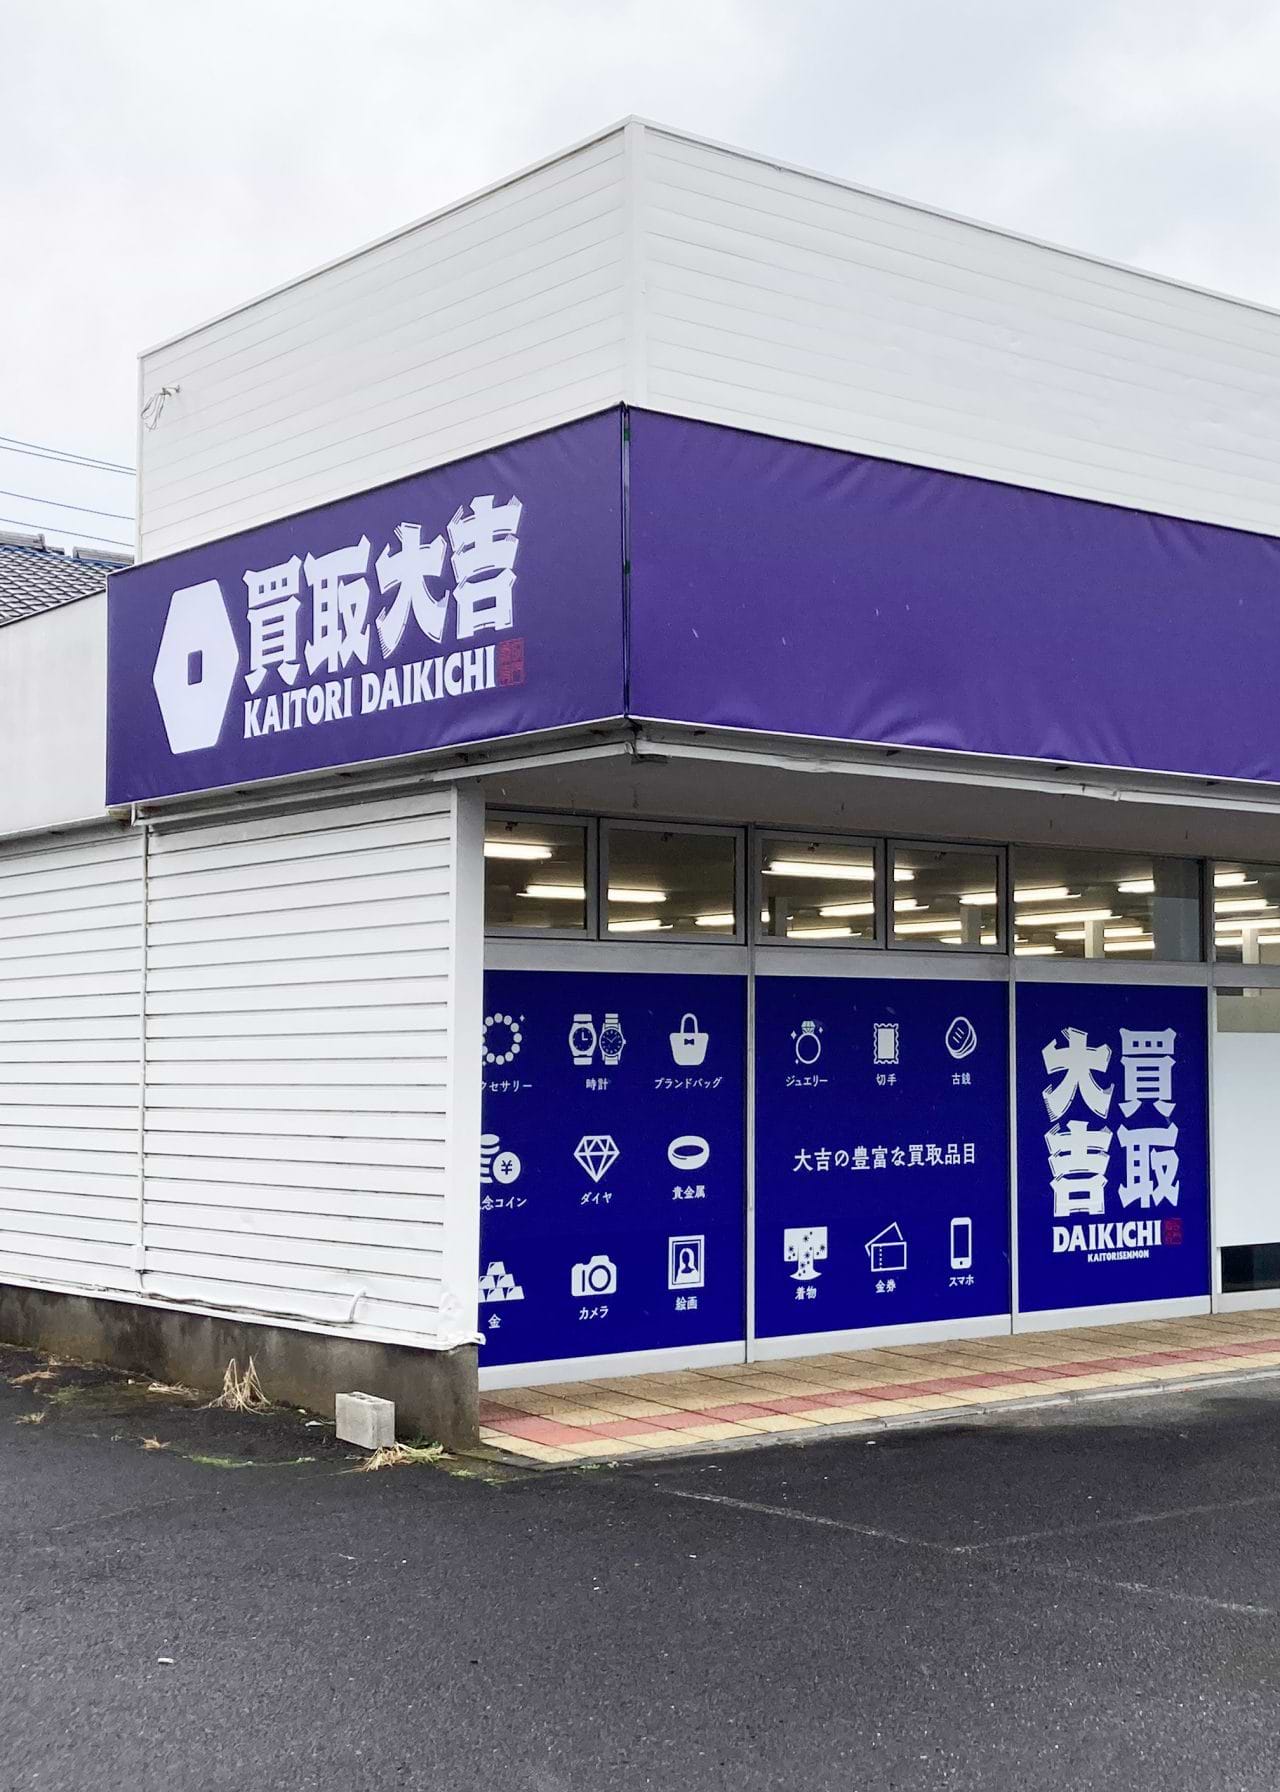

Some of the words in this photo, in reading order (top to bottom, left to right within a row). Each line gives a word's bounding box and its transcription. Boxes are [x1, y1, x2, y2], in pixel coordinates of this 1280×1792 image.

[243, 495, 523, 694] 買取大吉
[243, 677, 353, 738] KAITORI
[361, 644, 496, 715] DAIKICHI
[586, 1078, 609, 1091] 時計
[654, 1076, 723, 1090] ブランドバッグ
[786, 1075, 828, 1087] ジュエリー
[876, 1073, 897, 1086] 切手
[793, 1143, 975, 1171] 大吉の豊富な買取品目
[580, 1192, 613, 1205] ダイヤ
[672, 1186, 706, 1200] 貴金属
[480, 1195, 527, 1210] 念コイン
[1052, 1220, 1162, 1253] DAIKICHI
[1087, 1249, 1150, 1263] KAITORISENMON
[875, 1280, 896, 1293] 金券
[949, 1274, 974, 1287] スマホ
[795, 1286, 817, 1300] 着物
[675, 1297, 698, 1311] 絵画
[579, 1306, 609, 1320] カメラ
[488, 1314, 502, 1329] 金
